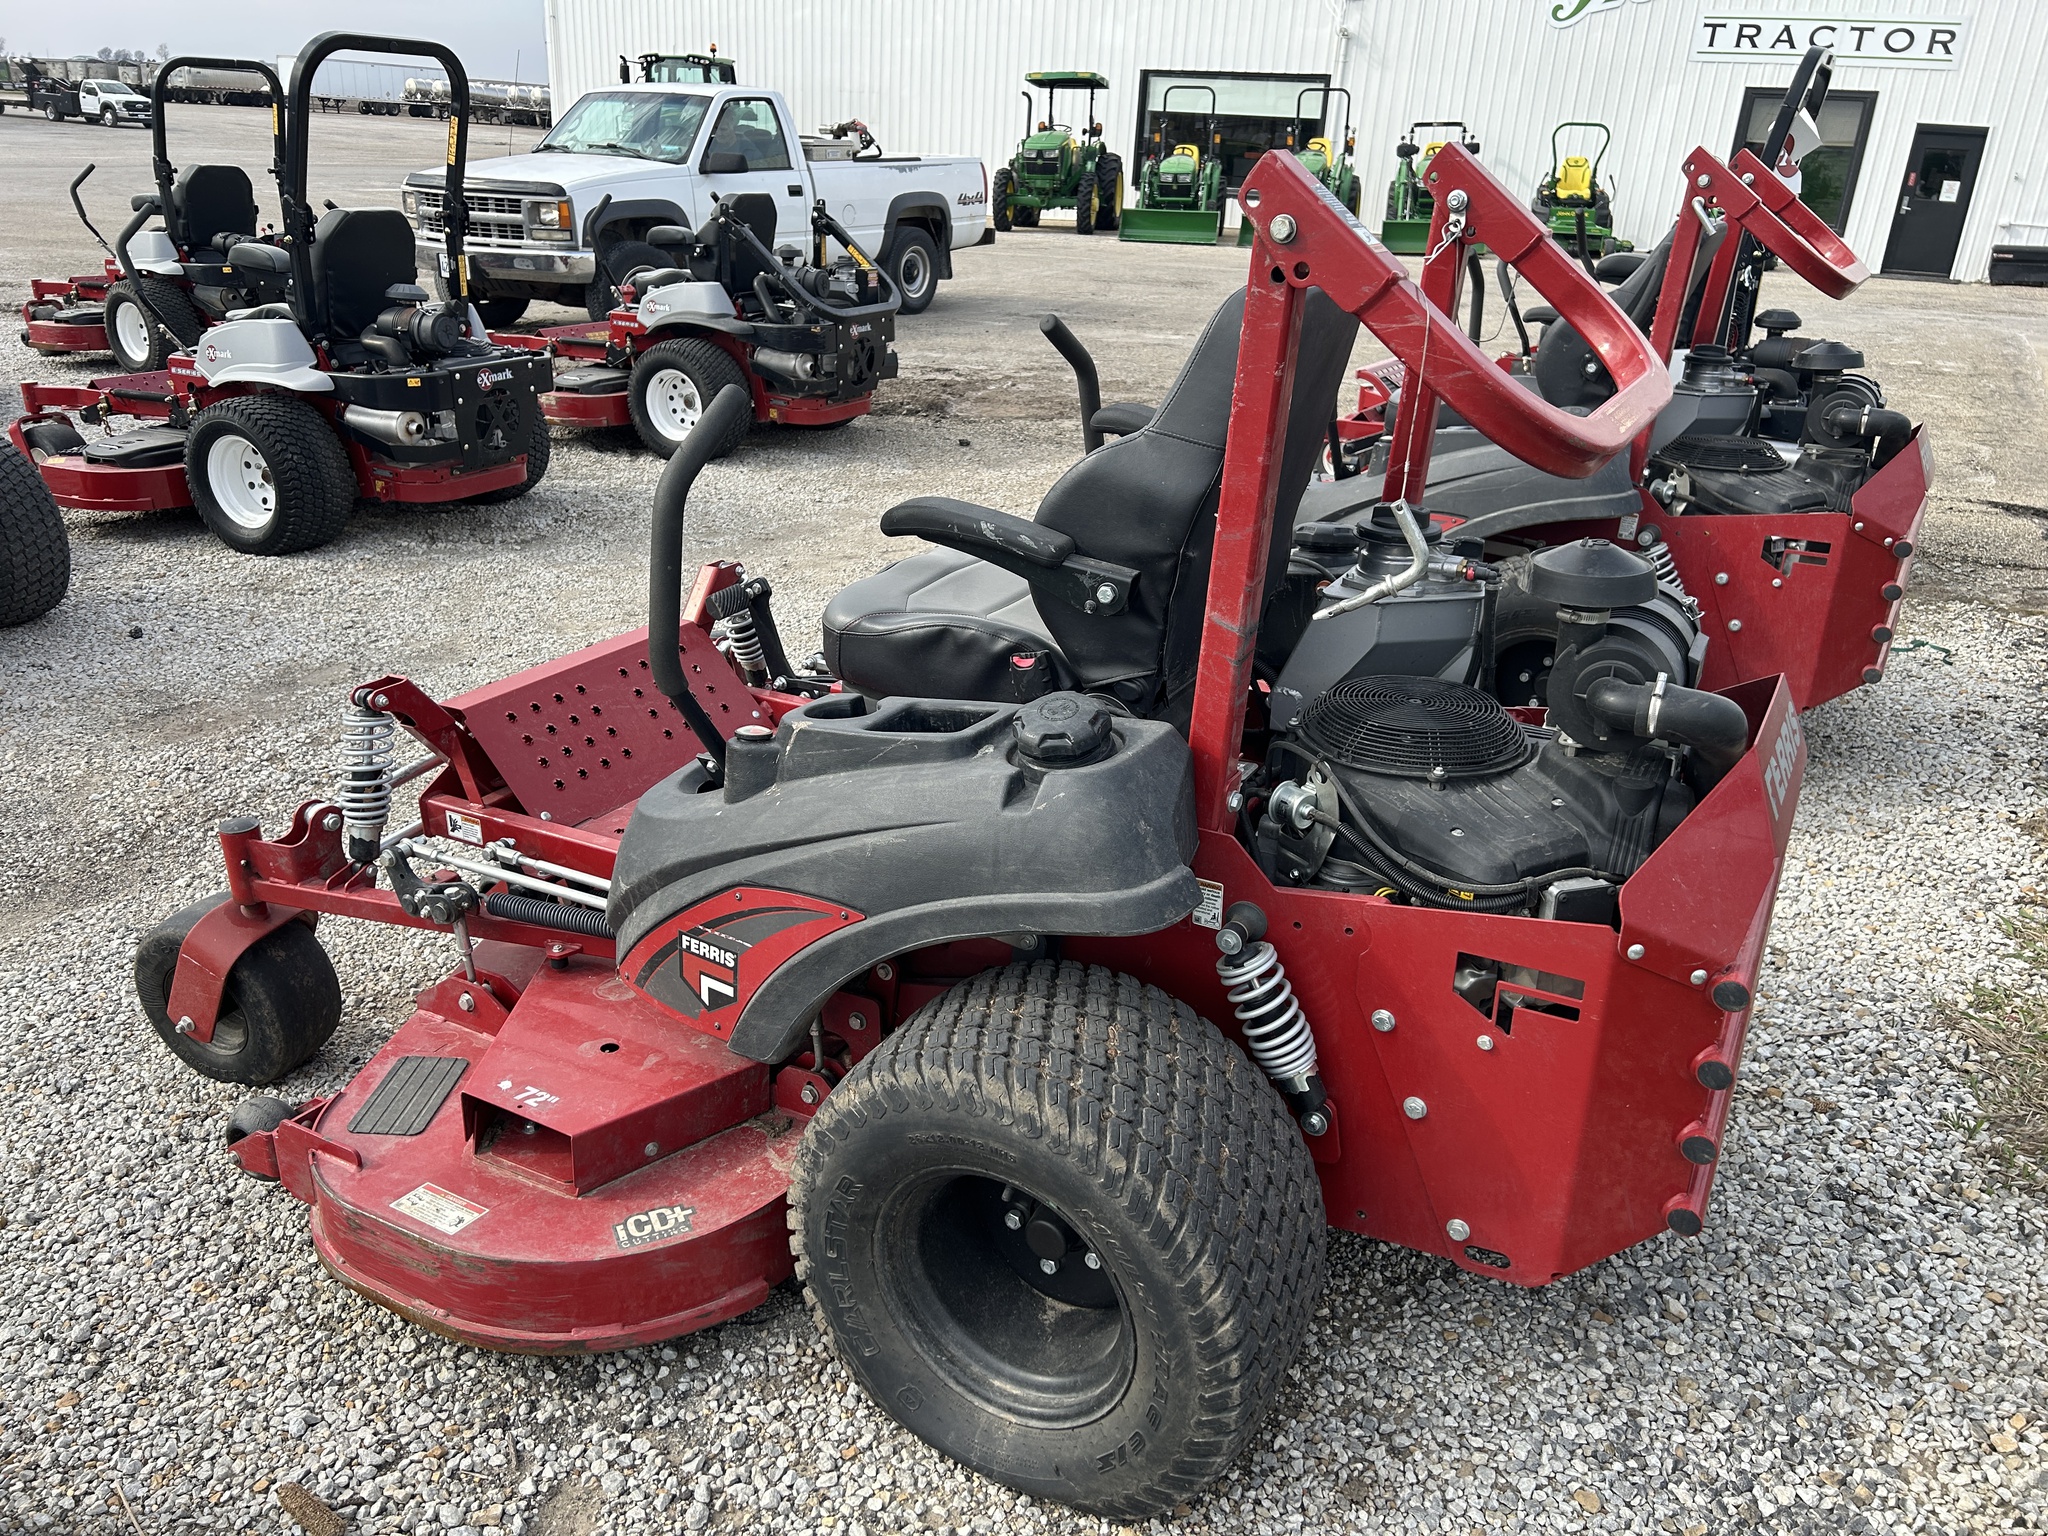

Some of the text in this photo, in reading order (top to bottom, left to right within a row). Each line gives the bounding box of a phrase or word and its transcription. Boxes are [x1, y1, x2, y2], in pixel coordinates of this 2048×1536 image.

[1703, 22, 1957, 55] TRACTOR
[1764, 700, 1800, 822] FERRIS
[682, 934, 735, 968] FERRIS
[513, 1085, 560, 1107] 72"
[621, 1225, 690, 1248] CUTTING
[825, 1174, 882, 1357] CARLSTAR
